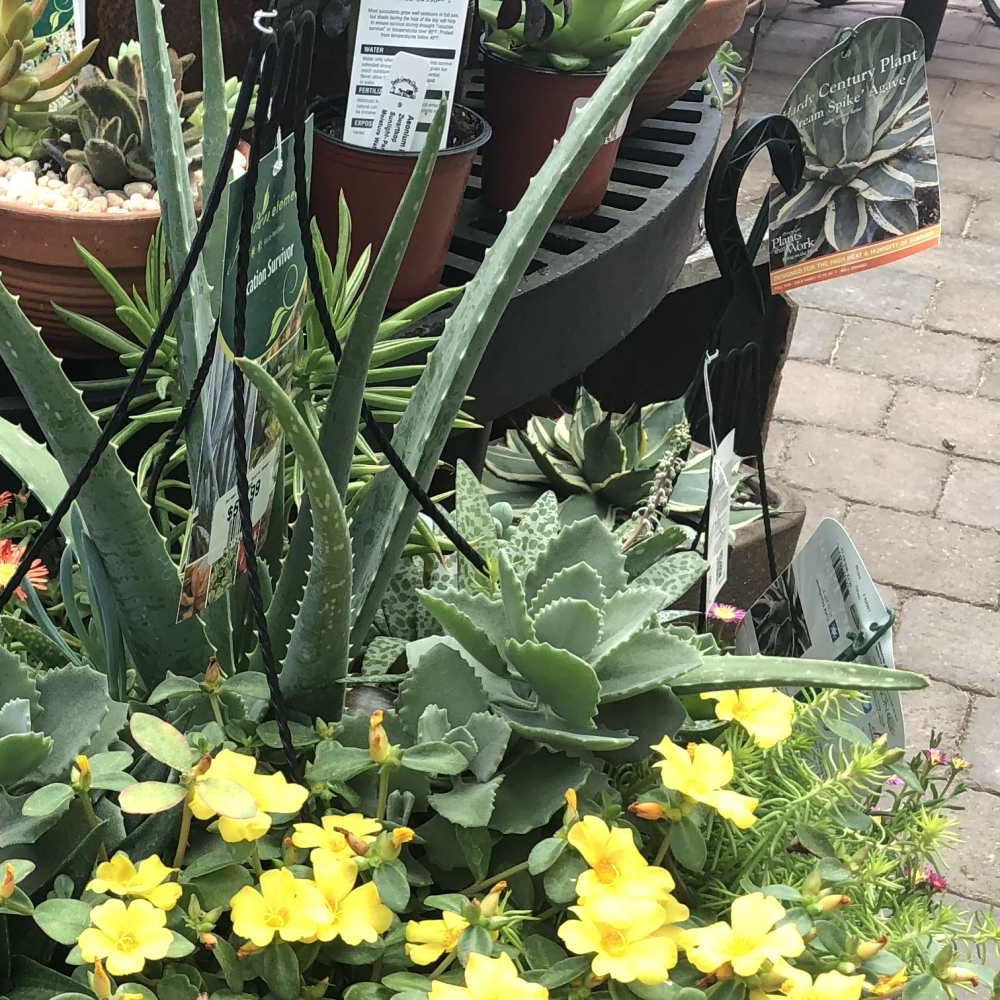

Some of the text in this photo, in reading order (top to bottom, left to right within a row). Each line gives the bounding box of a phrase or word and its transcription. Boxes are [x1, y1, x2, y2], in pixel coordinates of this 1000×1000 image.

[363, 46, 385, 54] WATER
[818, 67, 876, 98] Century
[879, 50, 919, 74] Plant
[868, 76, 907, 98] Agave
[400, 114, 415, 147] Aeonium
[771, 232, 802, 248] Plants
[267, 242, 295, 279] Survivor
